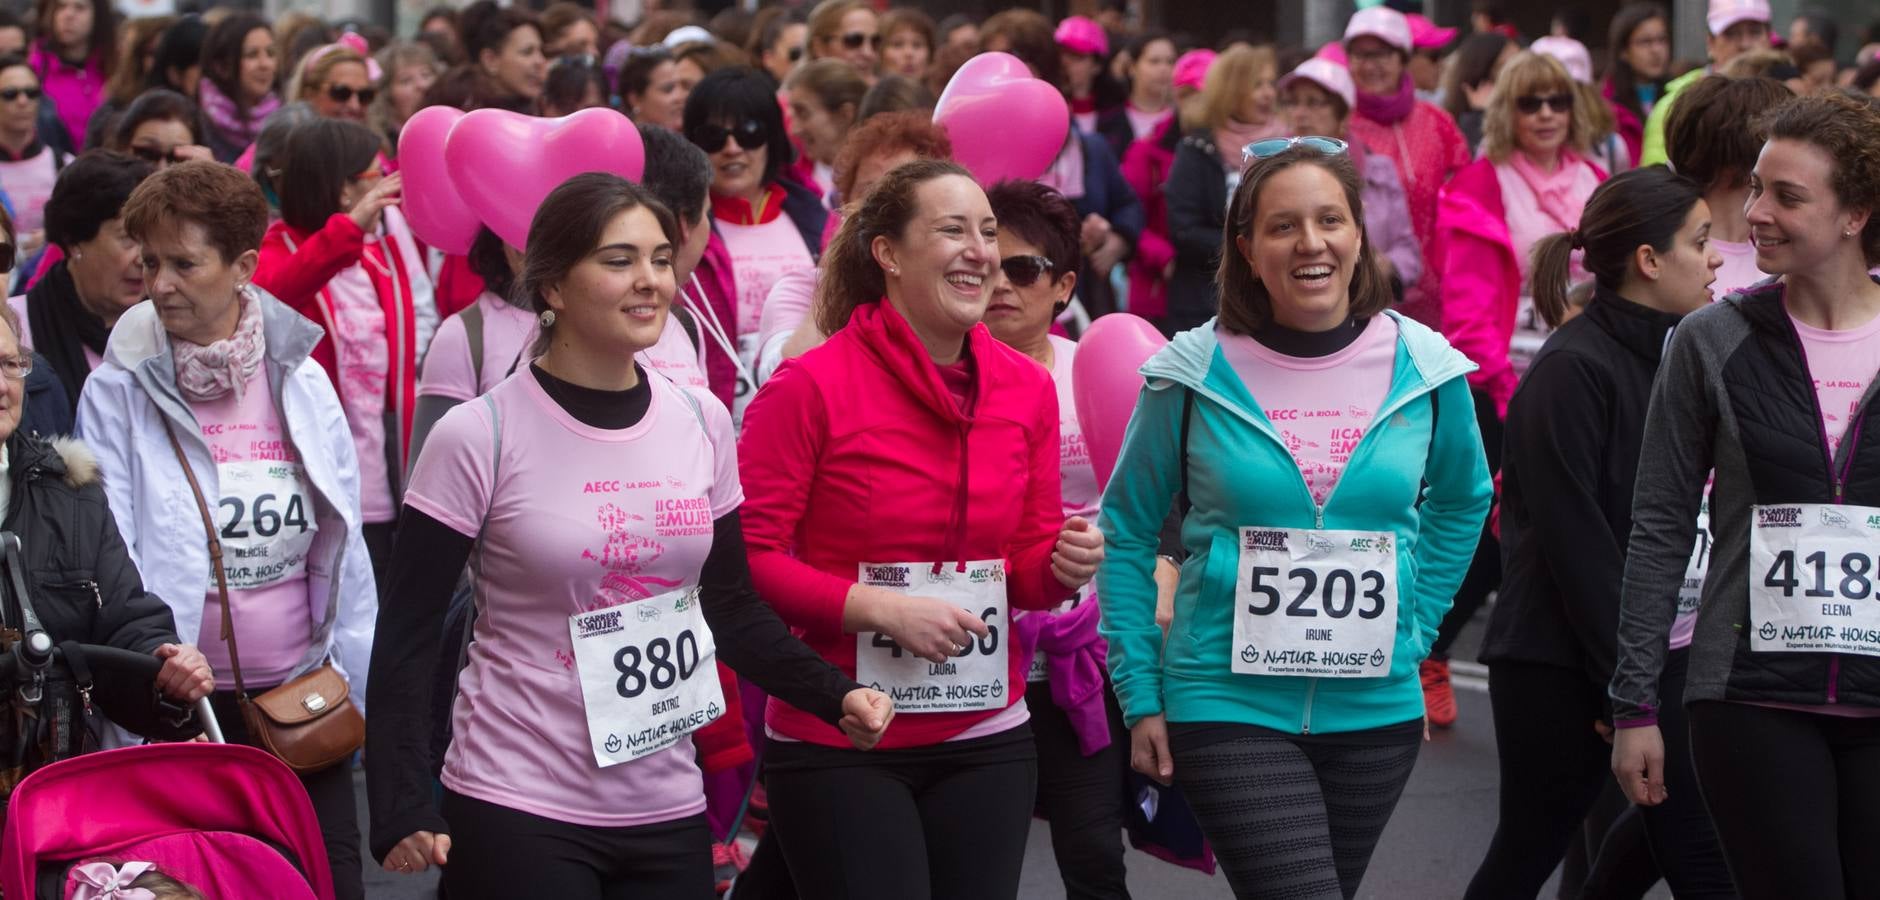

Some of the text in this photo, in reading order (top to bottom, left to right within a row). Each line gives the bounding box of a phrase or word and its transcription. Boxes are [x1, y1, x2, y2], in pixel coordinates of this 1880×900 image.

[202, 424, 223, 434] ECC
[1331, 429, 1340, 440] II
[584, 481, 620, 493] AECC
[638, 480, 661, 489] RIOJA
[656, 500, 664, 512] II
[1765, 507, 1802, 516] CARRERA
[1765, 513, 1798, 523] MUJER
[1252, 530, 1288, 539] CARRERA
[1253, 536, 1284, 546] MUJER
[1350, 537, 1372, 548] AECC
[235, 546, 269, 558] MERCHE
[872, 566, 910, 574] CARRERA
[873, 571, 905, 582] MUJER
[970, 568, 989, 578] AECC
[1764, 550, 1880, 600] 418
[1248, 566, 1386, 620] 5203
[1822, 603, 1852, 617] ELENA
[584, 610, 623, 624] CARRERA
[586, 618, 620, 632] MUJER
[1305, 628, 1333, 641] IRUNE
[1781, 625, 1836, 640] NATUR
[613, 629, 699, 698] 880
[1263, 650, 1369, 666] NATUR HOUSE
[929, 663, 957, 676] LAURA
[891, 684, 989, 701] NATUR HOUSE
[651, 695, 680, 716] BEATRIZ
[626, 709, 705, 750] NATUR HOUSE
